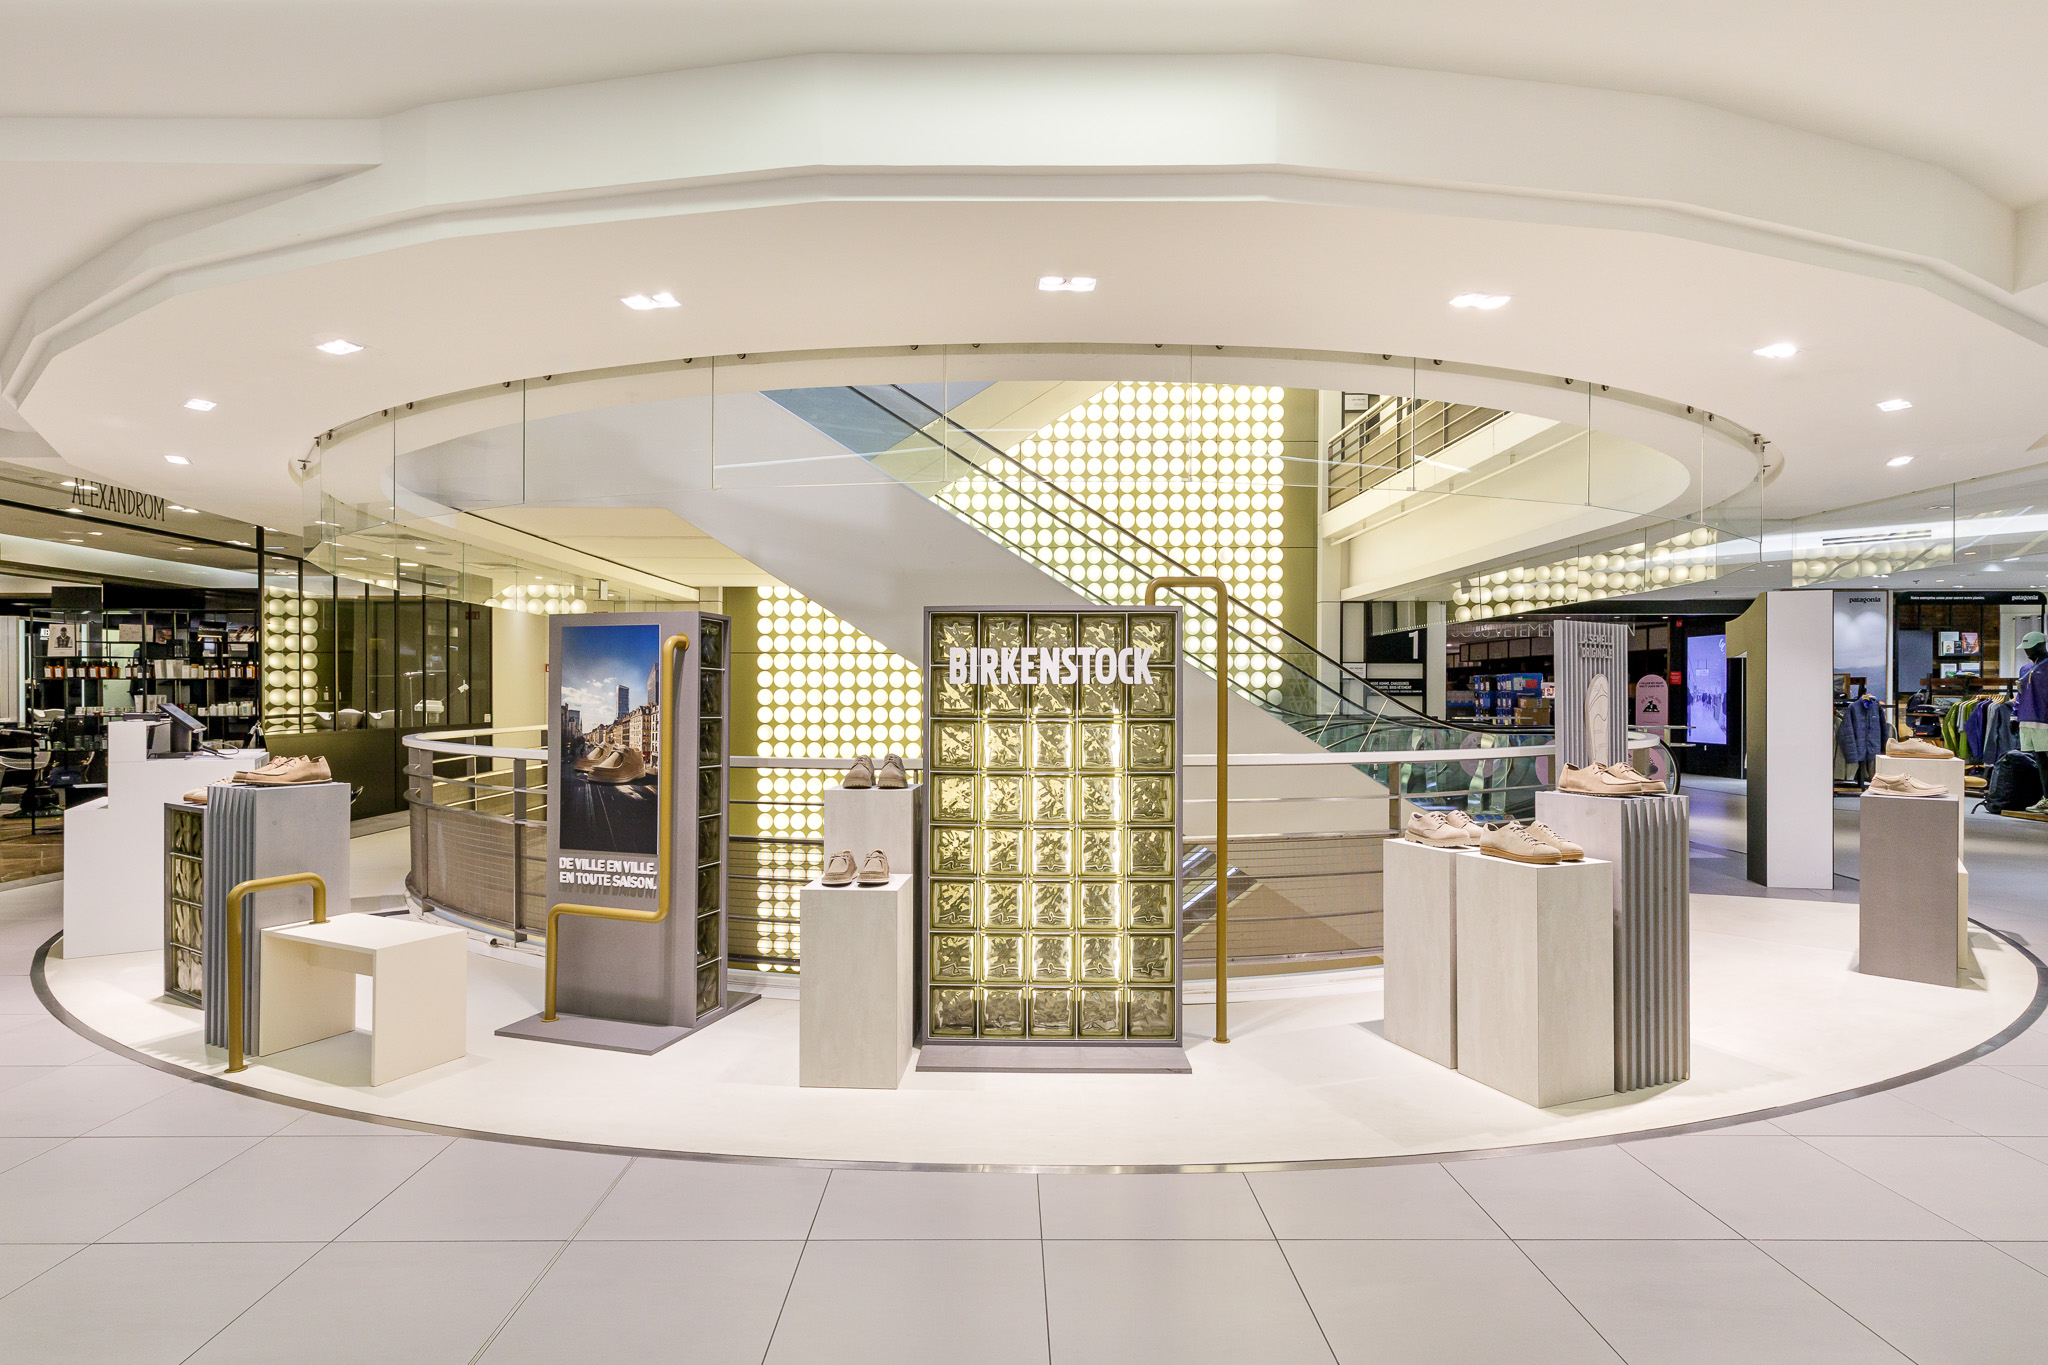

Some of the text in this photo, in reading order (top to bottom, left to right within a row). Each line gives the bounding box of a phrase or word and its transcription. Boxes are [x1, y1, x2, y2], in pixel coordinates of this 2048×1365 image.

[72, 477, 165, 522] ALEXANDROM
[1409, 630, 1419, 659] 1
[949, 646, 1154, 686] BIRKENSTOCK
[559, 857, 574, 869] DE
[575, 858, 605, 871] VILLE
[607, 860, 622, 873] EN
[560, 871, 657, 890] EN TOUTE SAISON.
